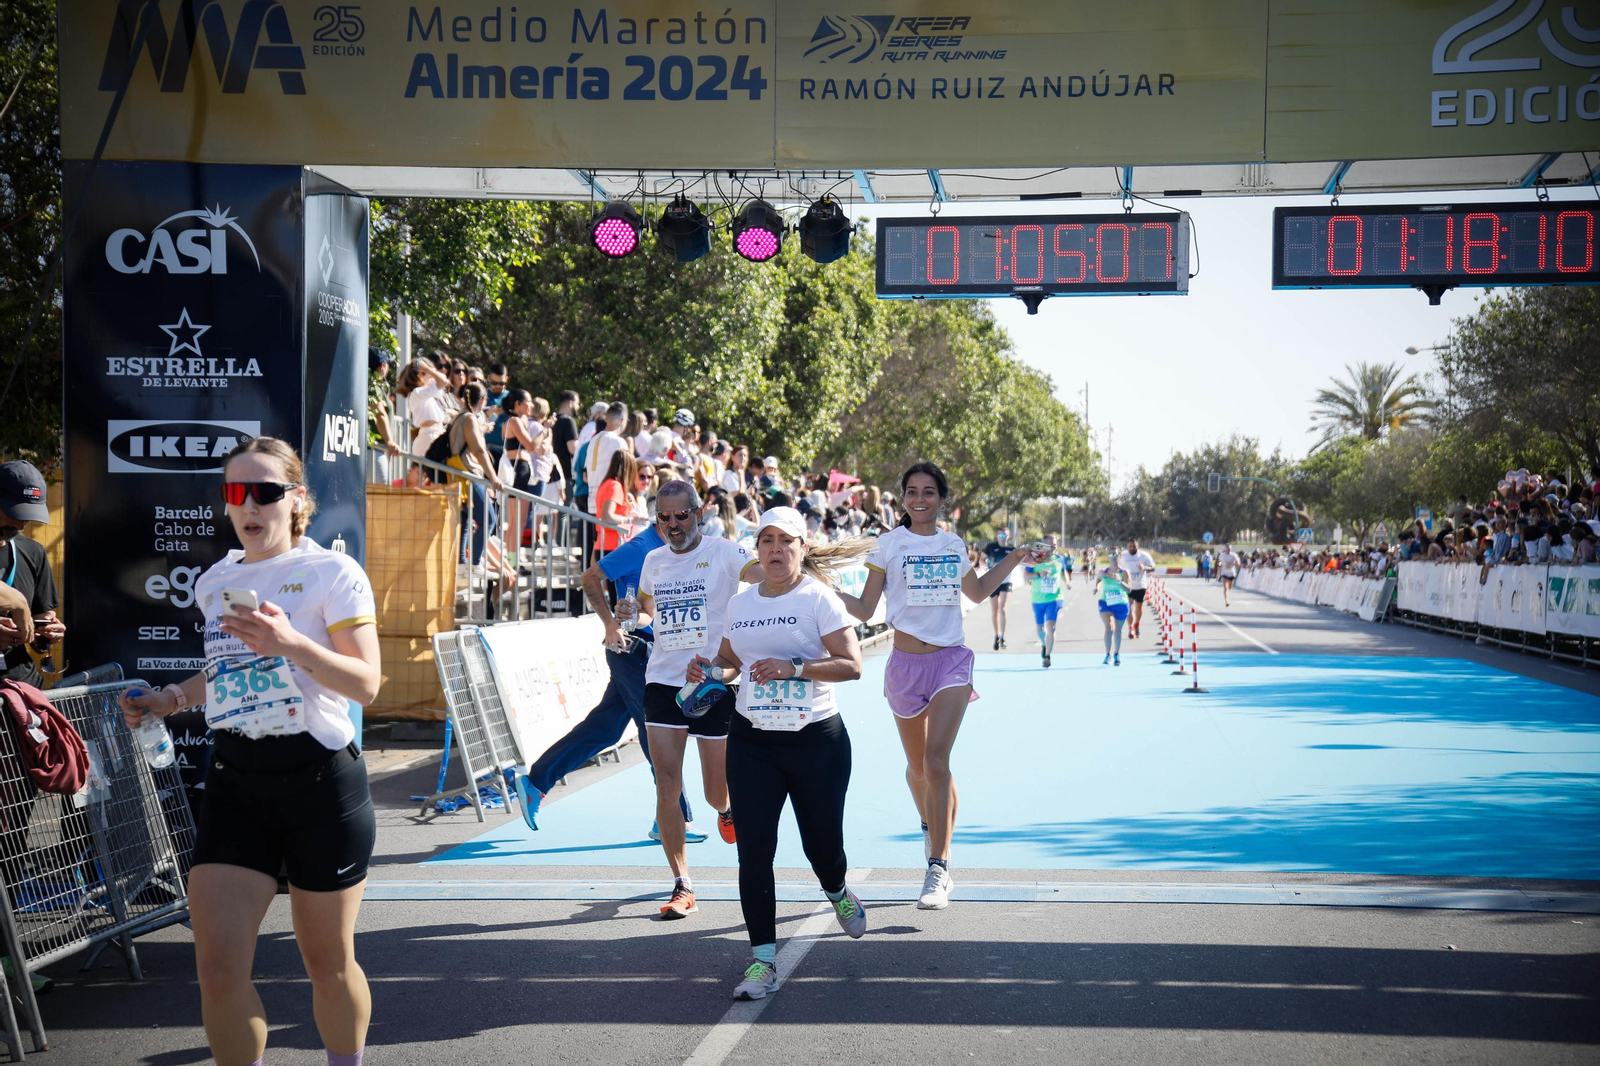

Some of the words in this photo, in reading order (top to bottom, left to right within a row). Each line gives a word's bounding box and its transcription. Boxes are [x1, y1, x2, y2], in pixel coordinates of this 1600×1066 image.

[313, 5, 365, 42] 25
[406, 6, 547, 43] Medio
[571, 7, 767, 45] Maratón
[894, 16, 972, 35] RFEA
[887, 35, 963, 49] SERIES
[313, 44, 365, 56] EDICIÓN
[880, 51, 928, 63] RUTA
[933, 50, 1008, 62] RUNNING
[403, 53, 610, 100] Almería
[623, 55, 768, 101] 2024
[800, 73, 916, 100] RAMÓN
[932, 77, 1006, 99] RUIZ
[1019, 69, 1175, 98] ANDÚJAR
[105, 228, 228, 275] CASI
[106, 357, 263, 377] ESTRELLA
[142, 377, 162, 388] DE
[164, 377, 229, 388] LEVANTE
[129, 436, 240, 458] IKEA
[154, 505, 213, 519] Barceló
[154, 522, 193, 536] Cabo
[196, 522, 215, 536] de
[154, 538, 190, 552] Gata
[913, 563, 958, 580] 5349
[145, 566, 202, 609] eg
[654, 581, 673, 589] Medio
[675, 578, 706, 587] Maratón
[654, 587, 681, 597] Almería
[683, 584, 706, 594] 2024
[660, 607, 701, 626] 5176
[730, 616, 798, 631] COSENTINO
[138, 626, 180, 640] SER
[138, 660, 151, 669] La
[152, 660, 172, 669] Voz
[173, 660, 187, 669] de
[753, 680, 807, 700] 5313
[241, 694, 259, 704] ANA
